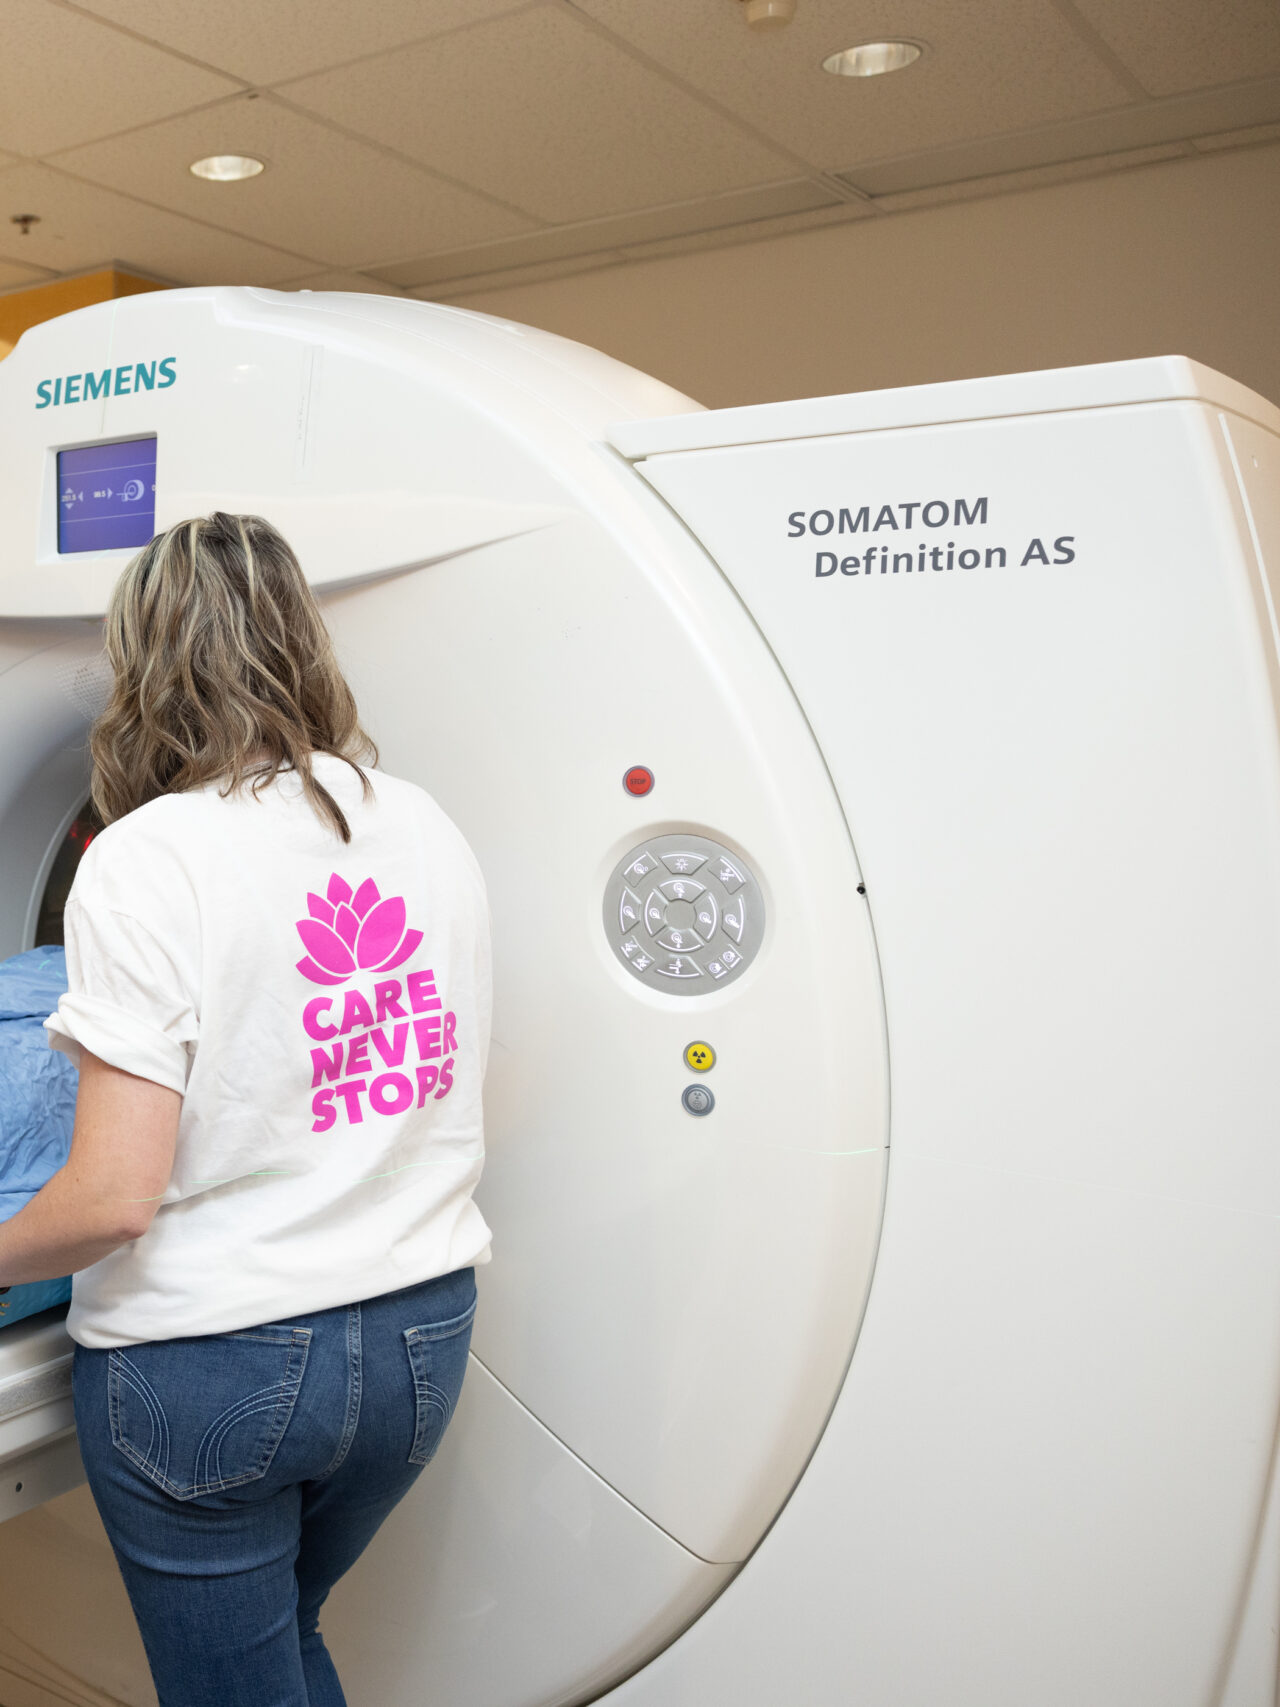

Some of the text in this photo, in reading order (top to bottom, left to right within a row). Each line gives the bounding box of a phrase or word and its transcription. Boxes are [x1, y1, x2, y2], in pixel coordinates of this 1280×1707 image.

[35, 356, 177, 409] SIEMENS
[787, 497, 988, 537] SOMATOM
[815, 536, 1076, 577] Definition AS
[303, 969, 442, 1041] CARE
[310, 1011, 458, 1088] NEVER
[311, 1057, 455, 1133] STOPS
